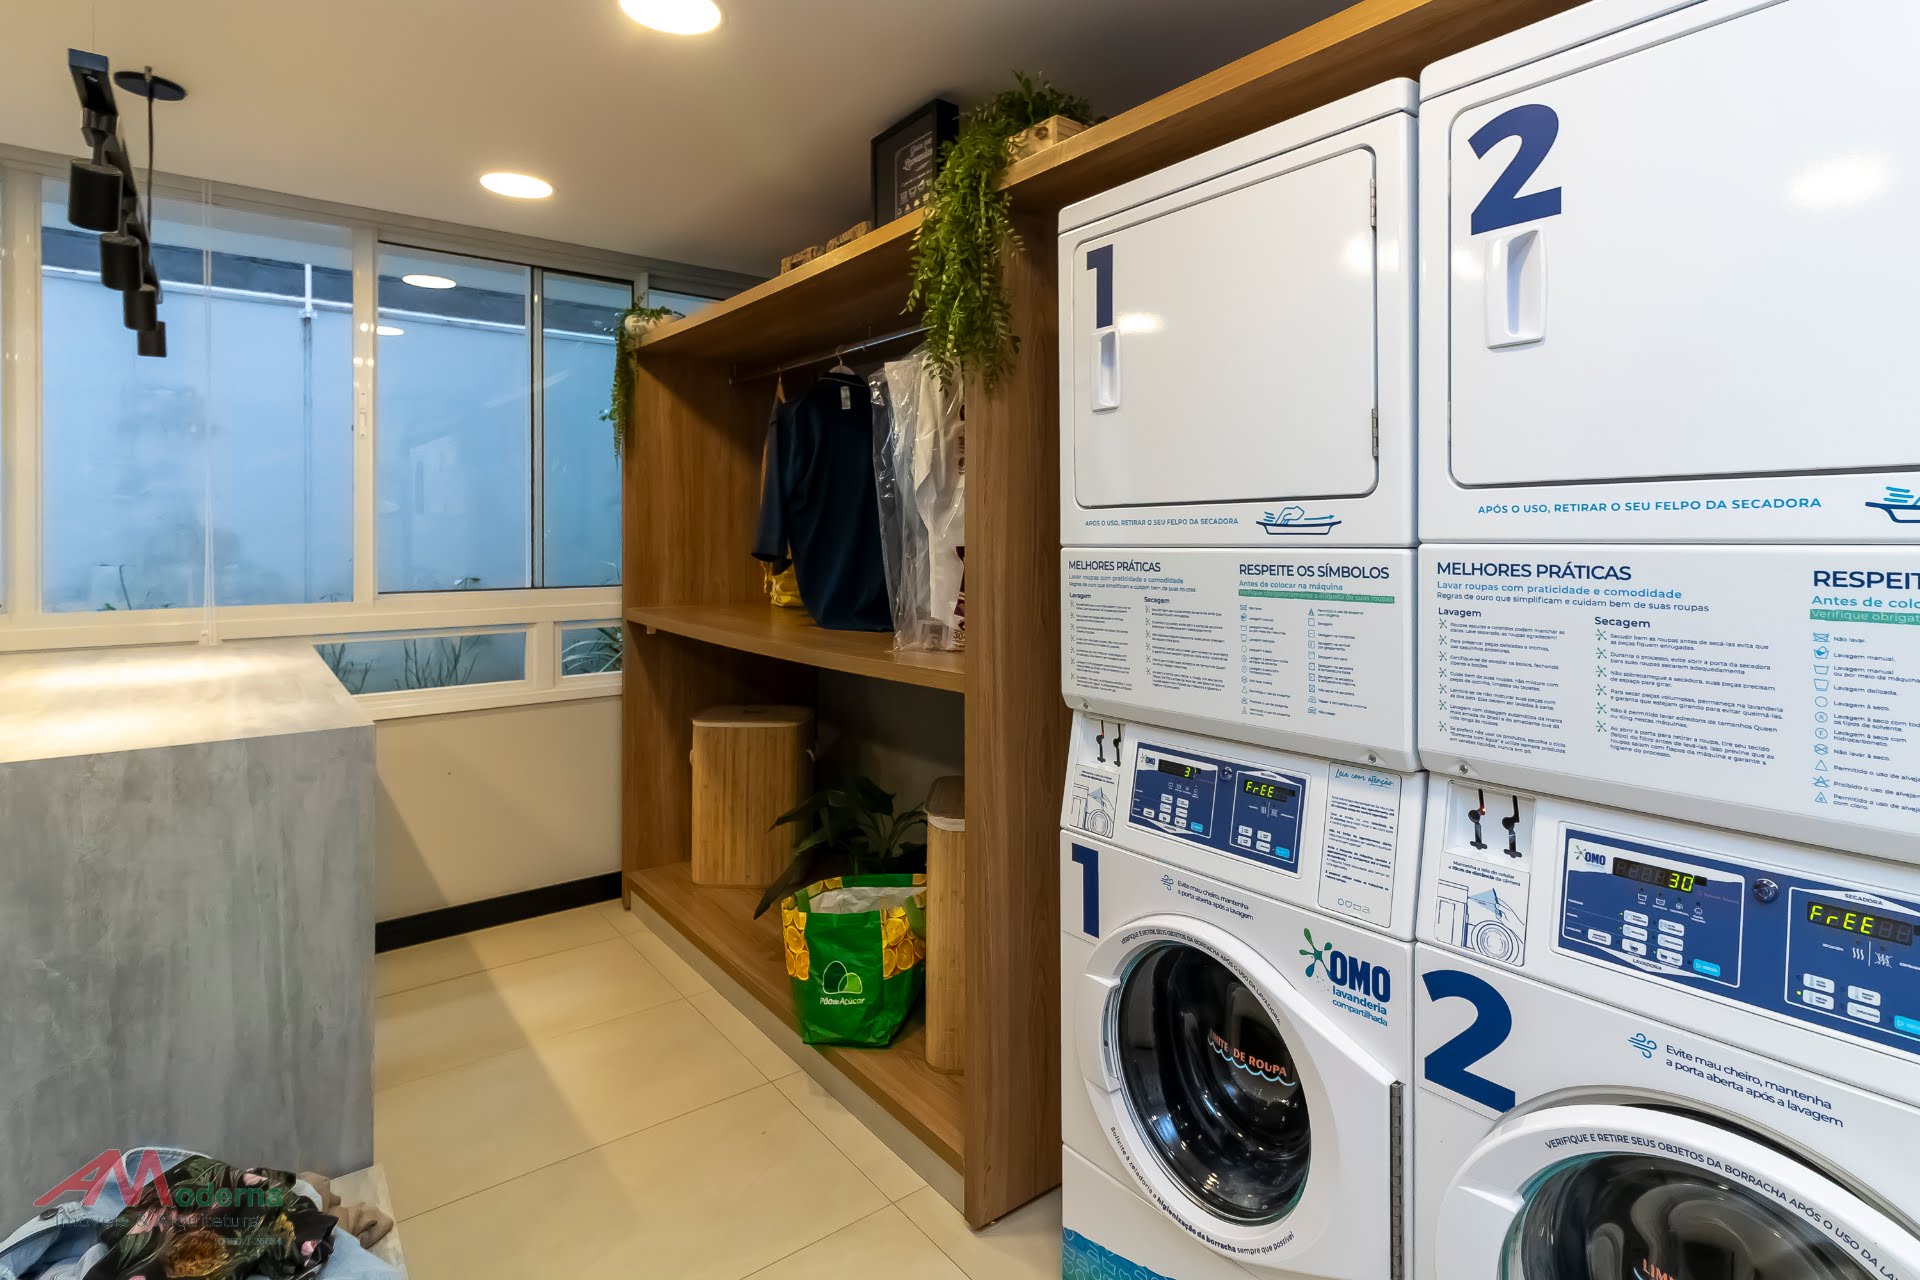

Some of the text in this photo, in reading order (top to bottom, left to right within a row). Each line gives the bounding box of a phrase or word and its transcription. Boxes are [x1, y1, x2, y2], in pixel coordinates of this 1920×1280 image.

[1468, 104, 1562, 235] 2
[1087, 244, 1113, 329] 1
[1478, 504, 1507, 513] APÓS
[1524, 505, 1550, 514] USO,
[1554, 503, 1607, 512] RETIRAR
[1611, 503, 1620, 511] O
[1625, 502, 1650, 510] SEU
[1656, 501, 1700, 510] FELPO
[1706, 500, 1727, 509] DA
[1732, 498, 1821, 509] SECADORA
[1069, 560, 1160, 572] MELHORES PRÁTICAS
[1240, 563, 1389, 579] RESPEITE OS SÍMBOLOS
[1438, 562, 1631, 580] MELHORES PRÁTICAS
[1465, 584, 1498, 592] roupas
[1527, 585, 1590, 595] praticidade
[1604, 588, 1682, 598] comodidade
[1144, 596, 1170, 605] Secagem
[1513, 596, 1562, 604] simplificam
[1674, 604, 1709, 613] roupas
[1812, 596, 1857, 606] Antes
[1863, 597, 1882, 607] de
[1439, 607, 1481, 618] Lavagem
[1812, 610, 1868, 620] Verifique
[1595, 617, 1650, 628] Secagem
[1335, 769, 1349, 778] Leia
[1368, 776, 1394, 786] atenção
[1585, 851, 1606, 865] OMO
[1072, 843, 1099, 938] 1
[1669, 873, 1693, 892] 30
[1178, 881, 1189, 889] Evite
[1190, 885, 1202, 894] mau
[1221, 896, 1248, 910] mantenha
[1845, 894, 1883, 905] SECADORA
[1182, 891, 1194, 900] porta
[1195, 896, 1211, 905] aberta
[1213, 901, 1225, 910] após
[1230, 908, 1253, 920] lavagem
[1810, 905, 1873, 934] FrEE
[1632, 958, 1662, 971] LAVADORA
[1330, 951, 1390, 1003] OMO
[840, 997, 865, 1005] Açúcar
[1333, 986, 1386, 1015] lavanderia
[1333, 1000, 1387, 1026] compartilhada
[1422, 970, 1516, 1114] 2
[1234, 1048, 1245, 1062] DE
[1249, 1056, 1287, 1076] ROUPA
[1667, 1044, 1832, 1109] Evite mau cheiro, mantenha
[1666, 1058, 1843, 1128] a porta aberta após a lavagem
[1110, 1126, 1127, 1156] Solicite
[1129, 1160, 1152, 1194] zeladoria
[1157, 1197, 1196, 1234] higienização
[1197, 1231, 1205, 1240] da
[1206, 1235, 1236, 1253] borracha
[1237, 1246, 1260, 1255] sempre
[1261, 1246, 1272, 1255] que
[1273, 1231, 1295, 1252] possível
[1545, 1134, 1589, 1150] VERIFIQUE
[1590, 1134, 1596, 1142] E
[1598, 1134, 1629, 1144] RETIRE
[1632, 1136, 1656, 1148] SEUS
[1658, 1142, 1704, 1163] OBJETOS
[1707, 1157, 1722, 1170] DA
[1725, 1164, 1787, 1202] BORRACHA
[1789, 1198, 1821, 1222] APÓS
[1824, 1220, 1832, 1229] O
[1835, 1228, 1859, 1250] USO
[1861, 1249, 1878, 1267] DA
